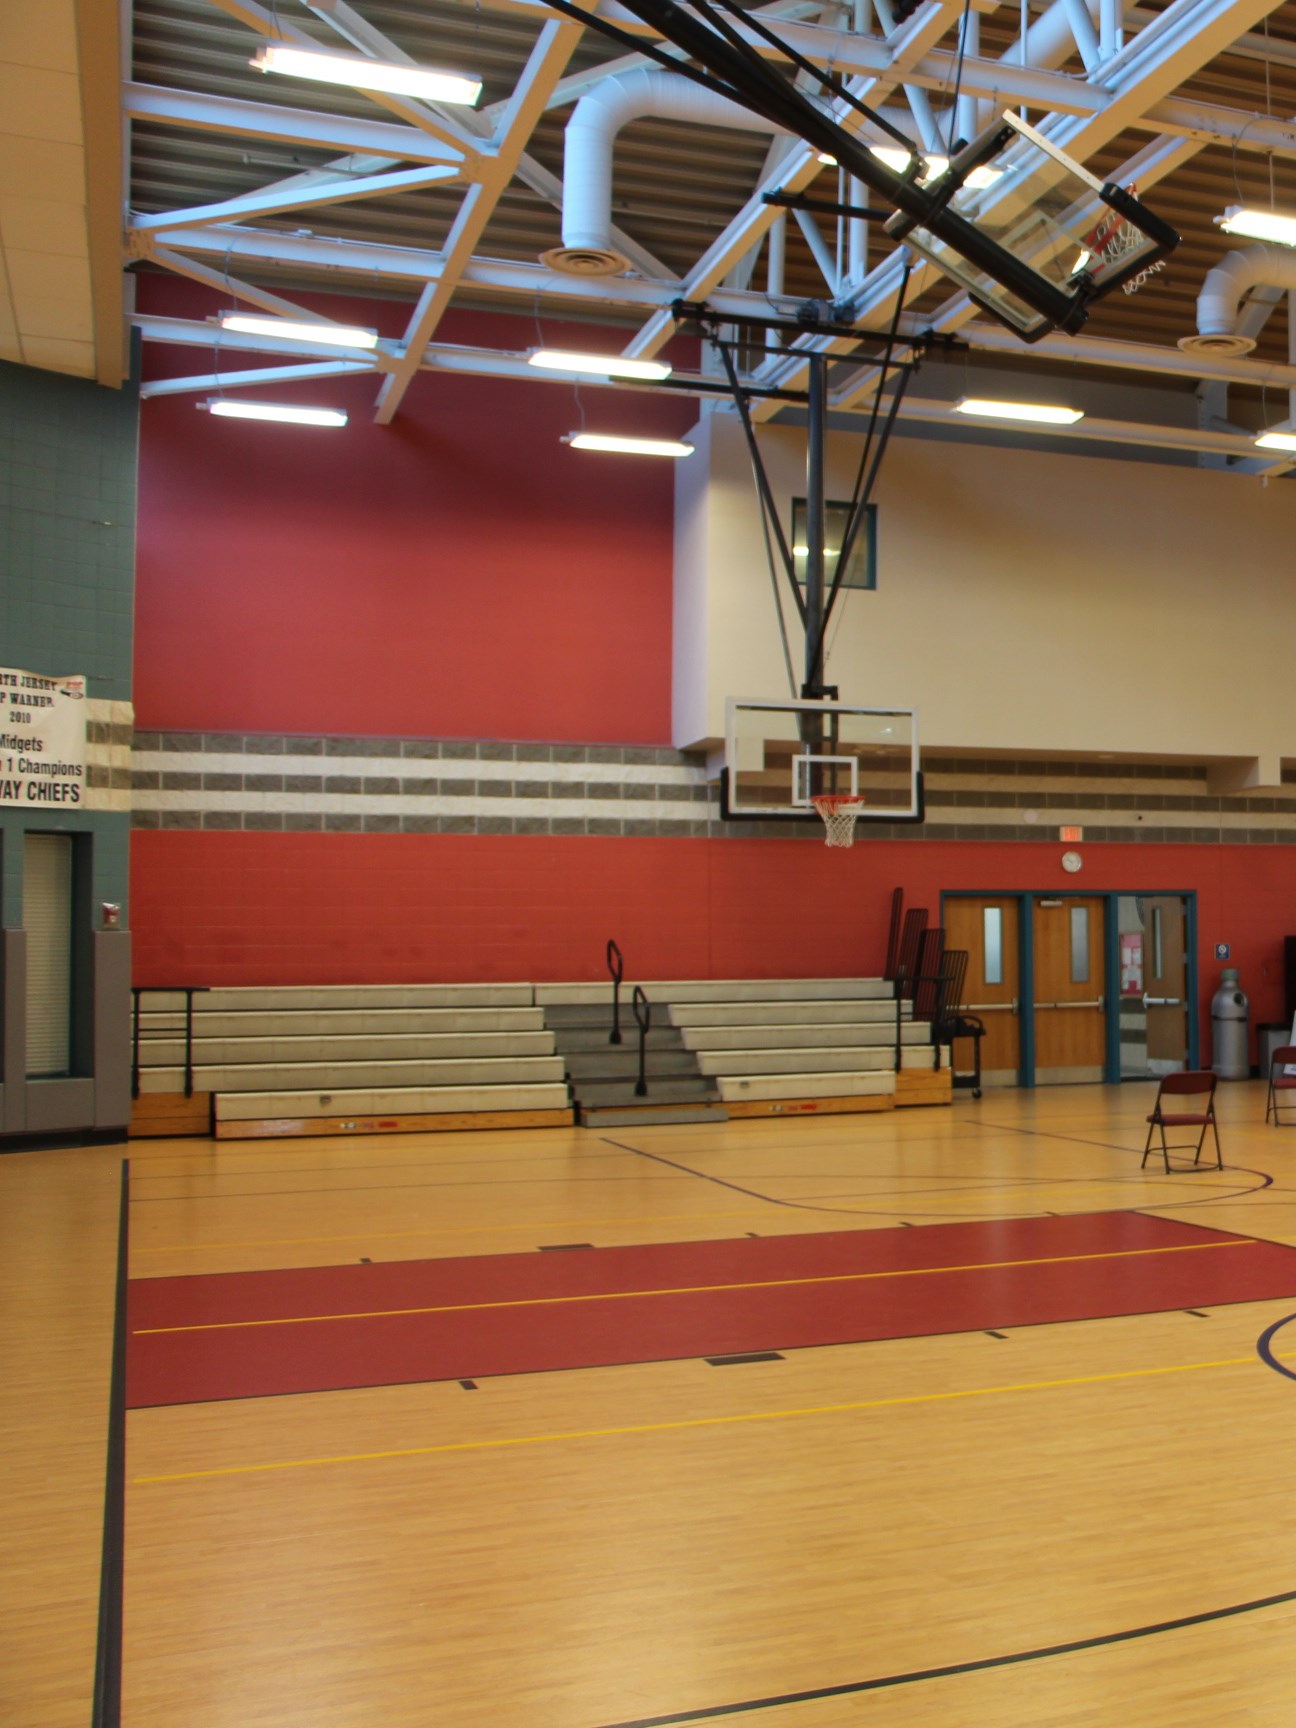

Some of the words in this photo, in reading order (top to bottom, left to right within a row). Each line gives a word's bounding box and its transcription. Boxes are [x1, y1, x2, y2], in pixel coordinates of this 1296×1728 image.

[20, 676, 57, 691] JERSEY
[10, 693, 54, 707] WARNER
[10, 711, 31, 724] 2010
[7, 757, 13, 772] 1
[18, 757, 83, 778] Champions
[27, 781, 80, 802] CHIEFS
